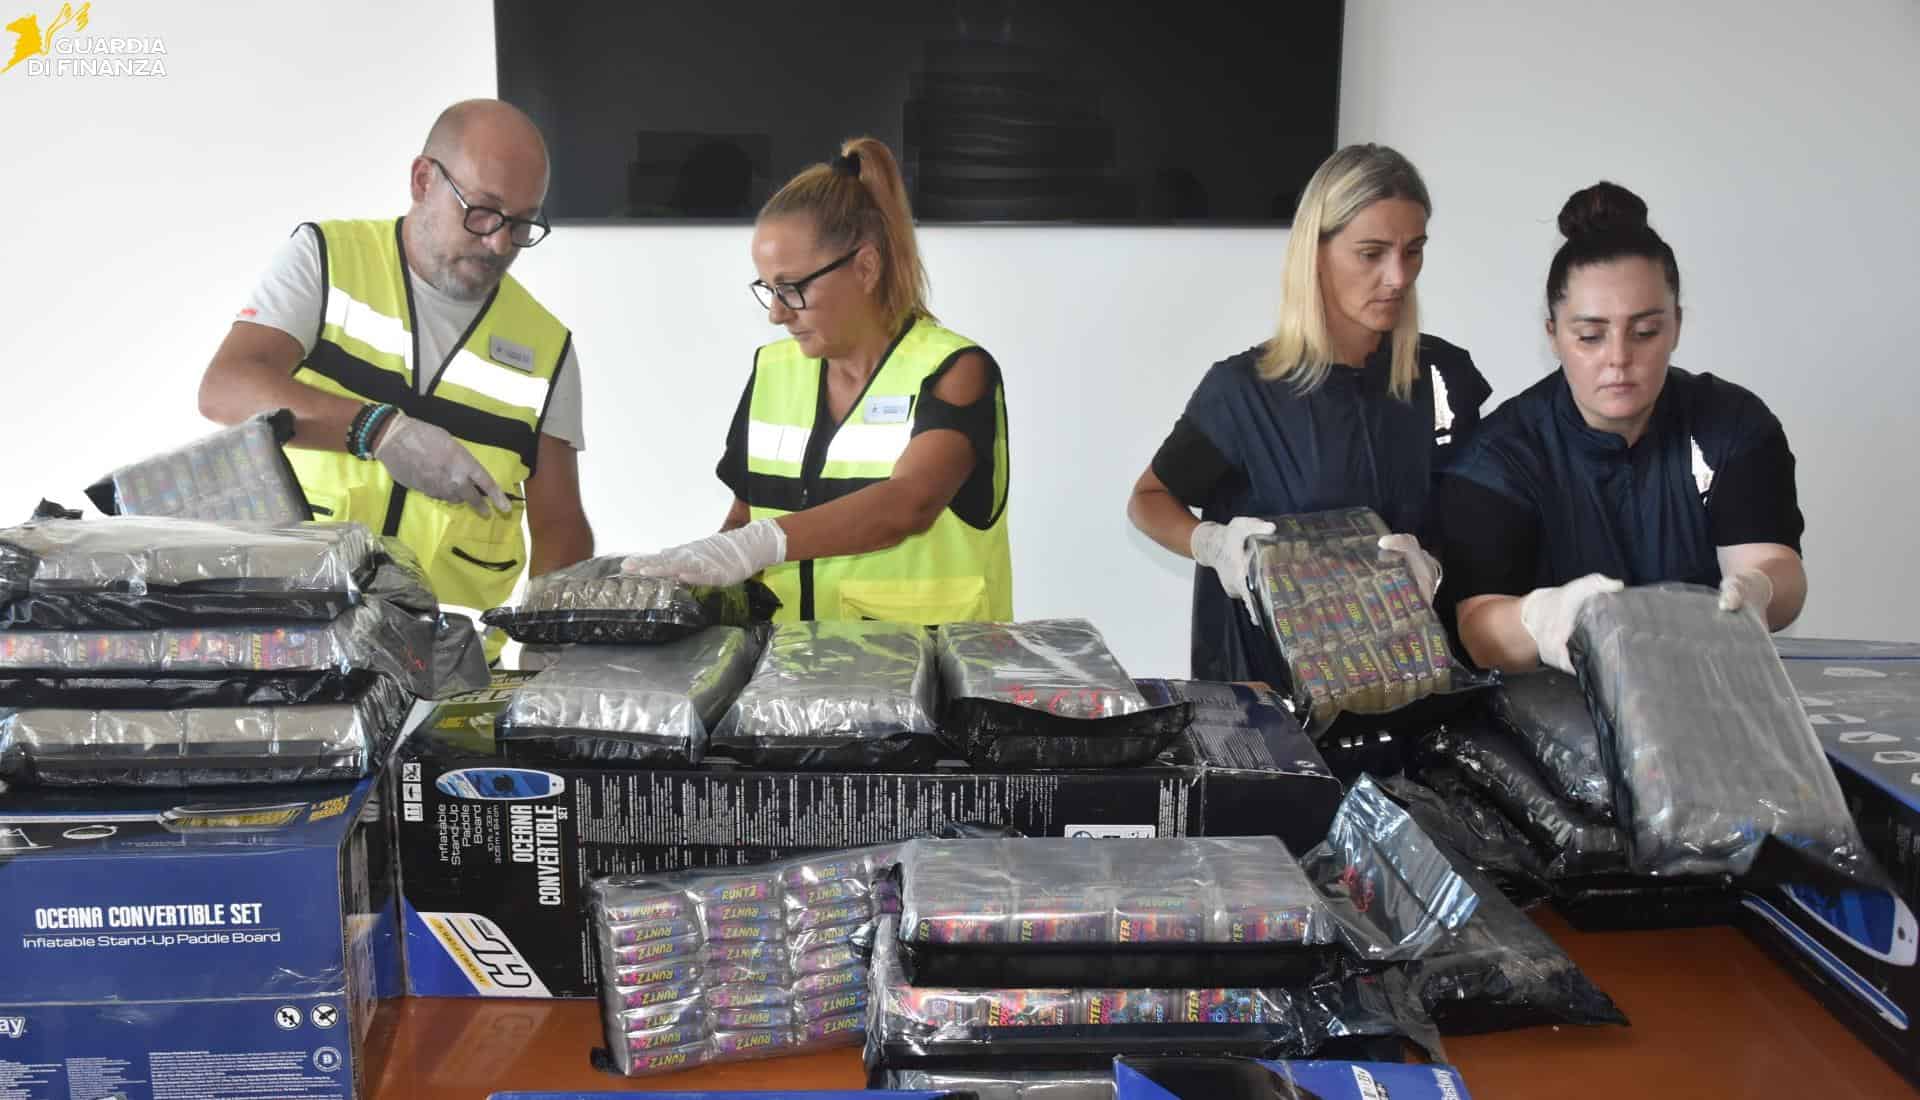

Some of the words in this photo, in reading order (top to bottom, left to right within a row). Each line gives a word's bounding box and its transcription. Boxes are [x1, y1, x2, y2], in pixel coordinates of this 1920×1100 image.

[558, 807, 568, 820] SET
[438, 804, 448, 861] Inflatable
[461, 805, 471, 847] Paddle
[472, 805, 483, 844] Board
[449, 804, 460, 865] Stand-Up
[510, 805, 534, 862] OCEANA
[535, 805, 560, 905] CONVERTIBLE
[808, 887, 842, 904] RUNTZ
[35, 907, 103, 929] OCEANA
[108, 904, 225, 928] CONVERTIBLE
[230, 903, 262, 924] SET
[722, 906, 760, 920] RUNTZ
[23, 936, 96, 948] Inflatable
[98, 935, 175, 947] Stand-Up
[176, 933, 230, 944] Paddle
[232, 932, 280, 943] Board
[636, 927, 672, 942] RUNTZ
[724, 927, 760, 938] RUNTZ
[638, 944, 672, 960] RUNTZ
[637, 970, 673, 985] RUNTZ
[642, 989, 678, 1005] RUNTZ
[822, 993, 856, 1013] RUNTZ
[823, 1017, 858, 1034] RUNTZ
[735, 1033, 770, 1050] RUNTZ
[649, 1054, 686, 1068] RUNTZ
